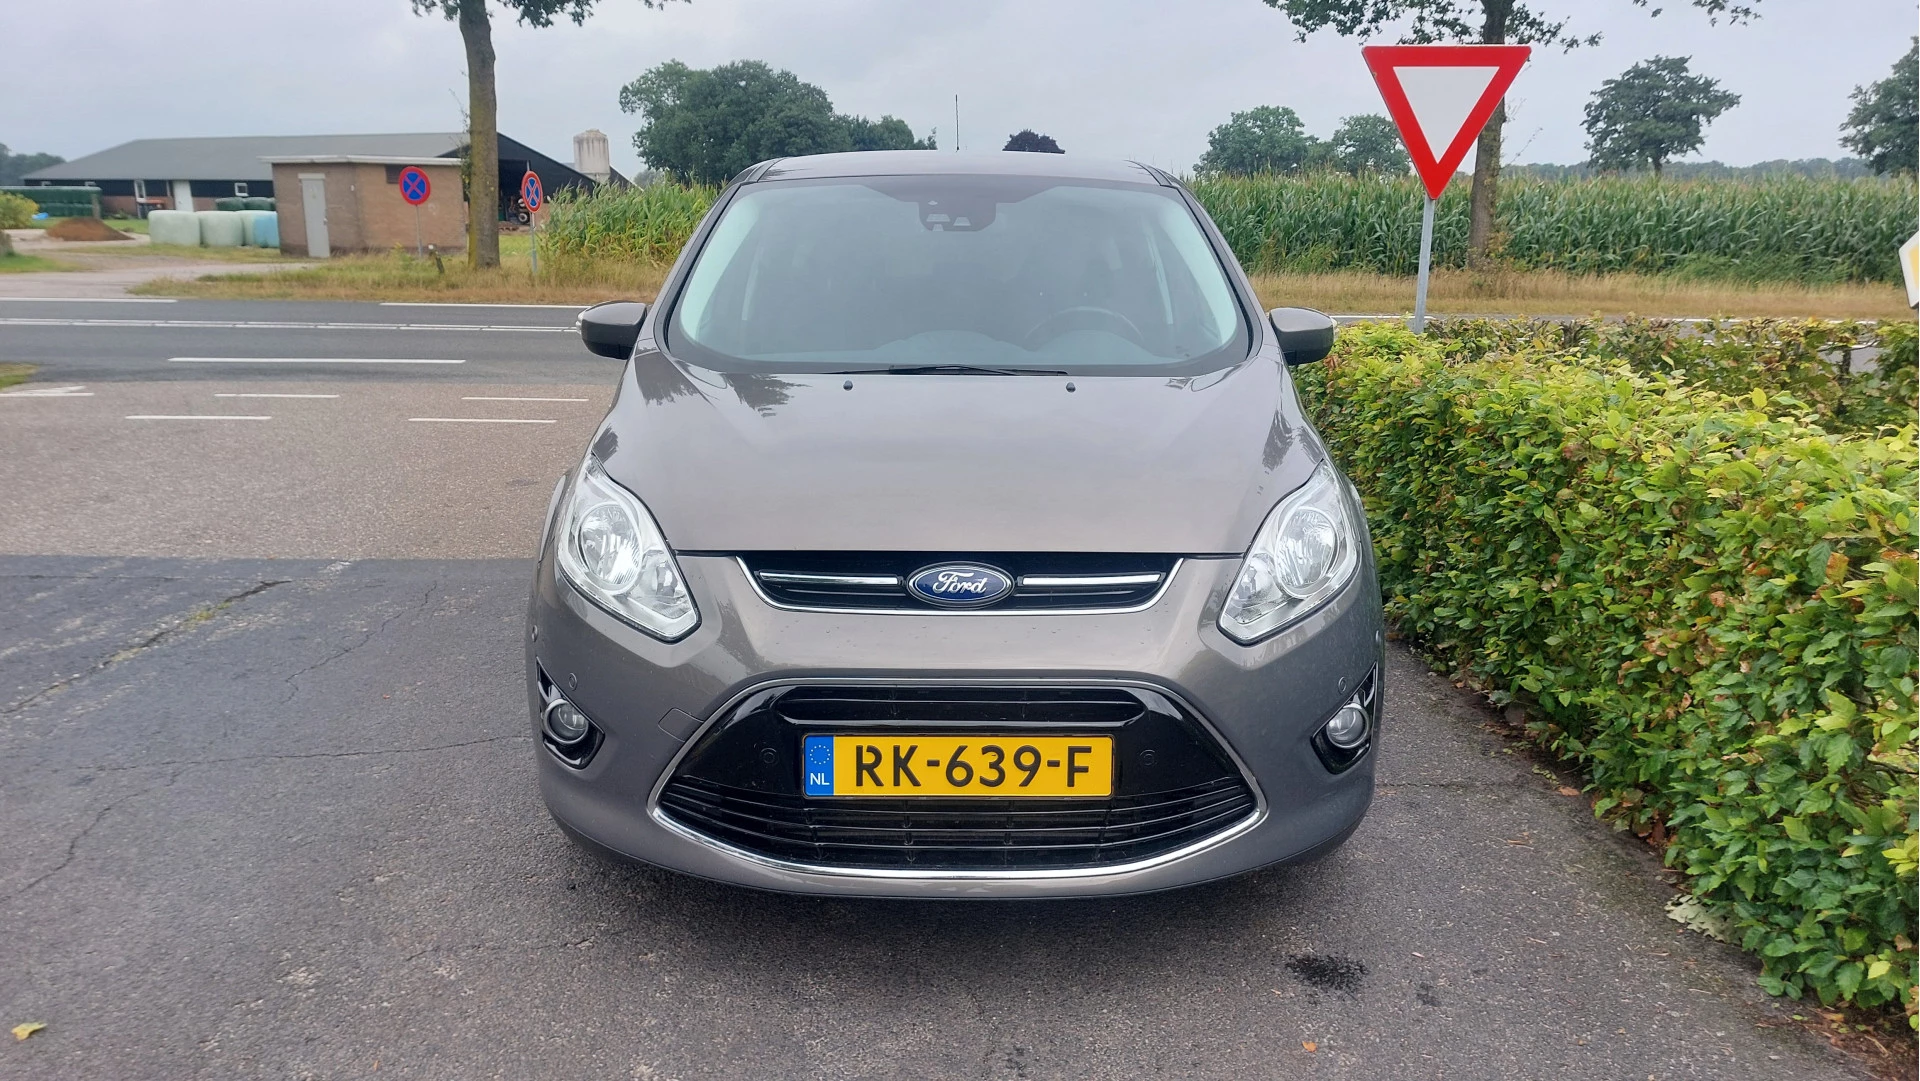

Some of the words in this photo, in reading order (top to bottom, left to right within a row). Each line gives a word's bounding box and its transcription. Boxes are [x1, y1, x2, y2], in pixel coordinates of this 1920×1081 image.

[932, 571, 988, 594] Ford
[855, 744, 1092, 787] RK-639-F
[810, 773, 830, 786] NL
